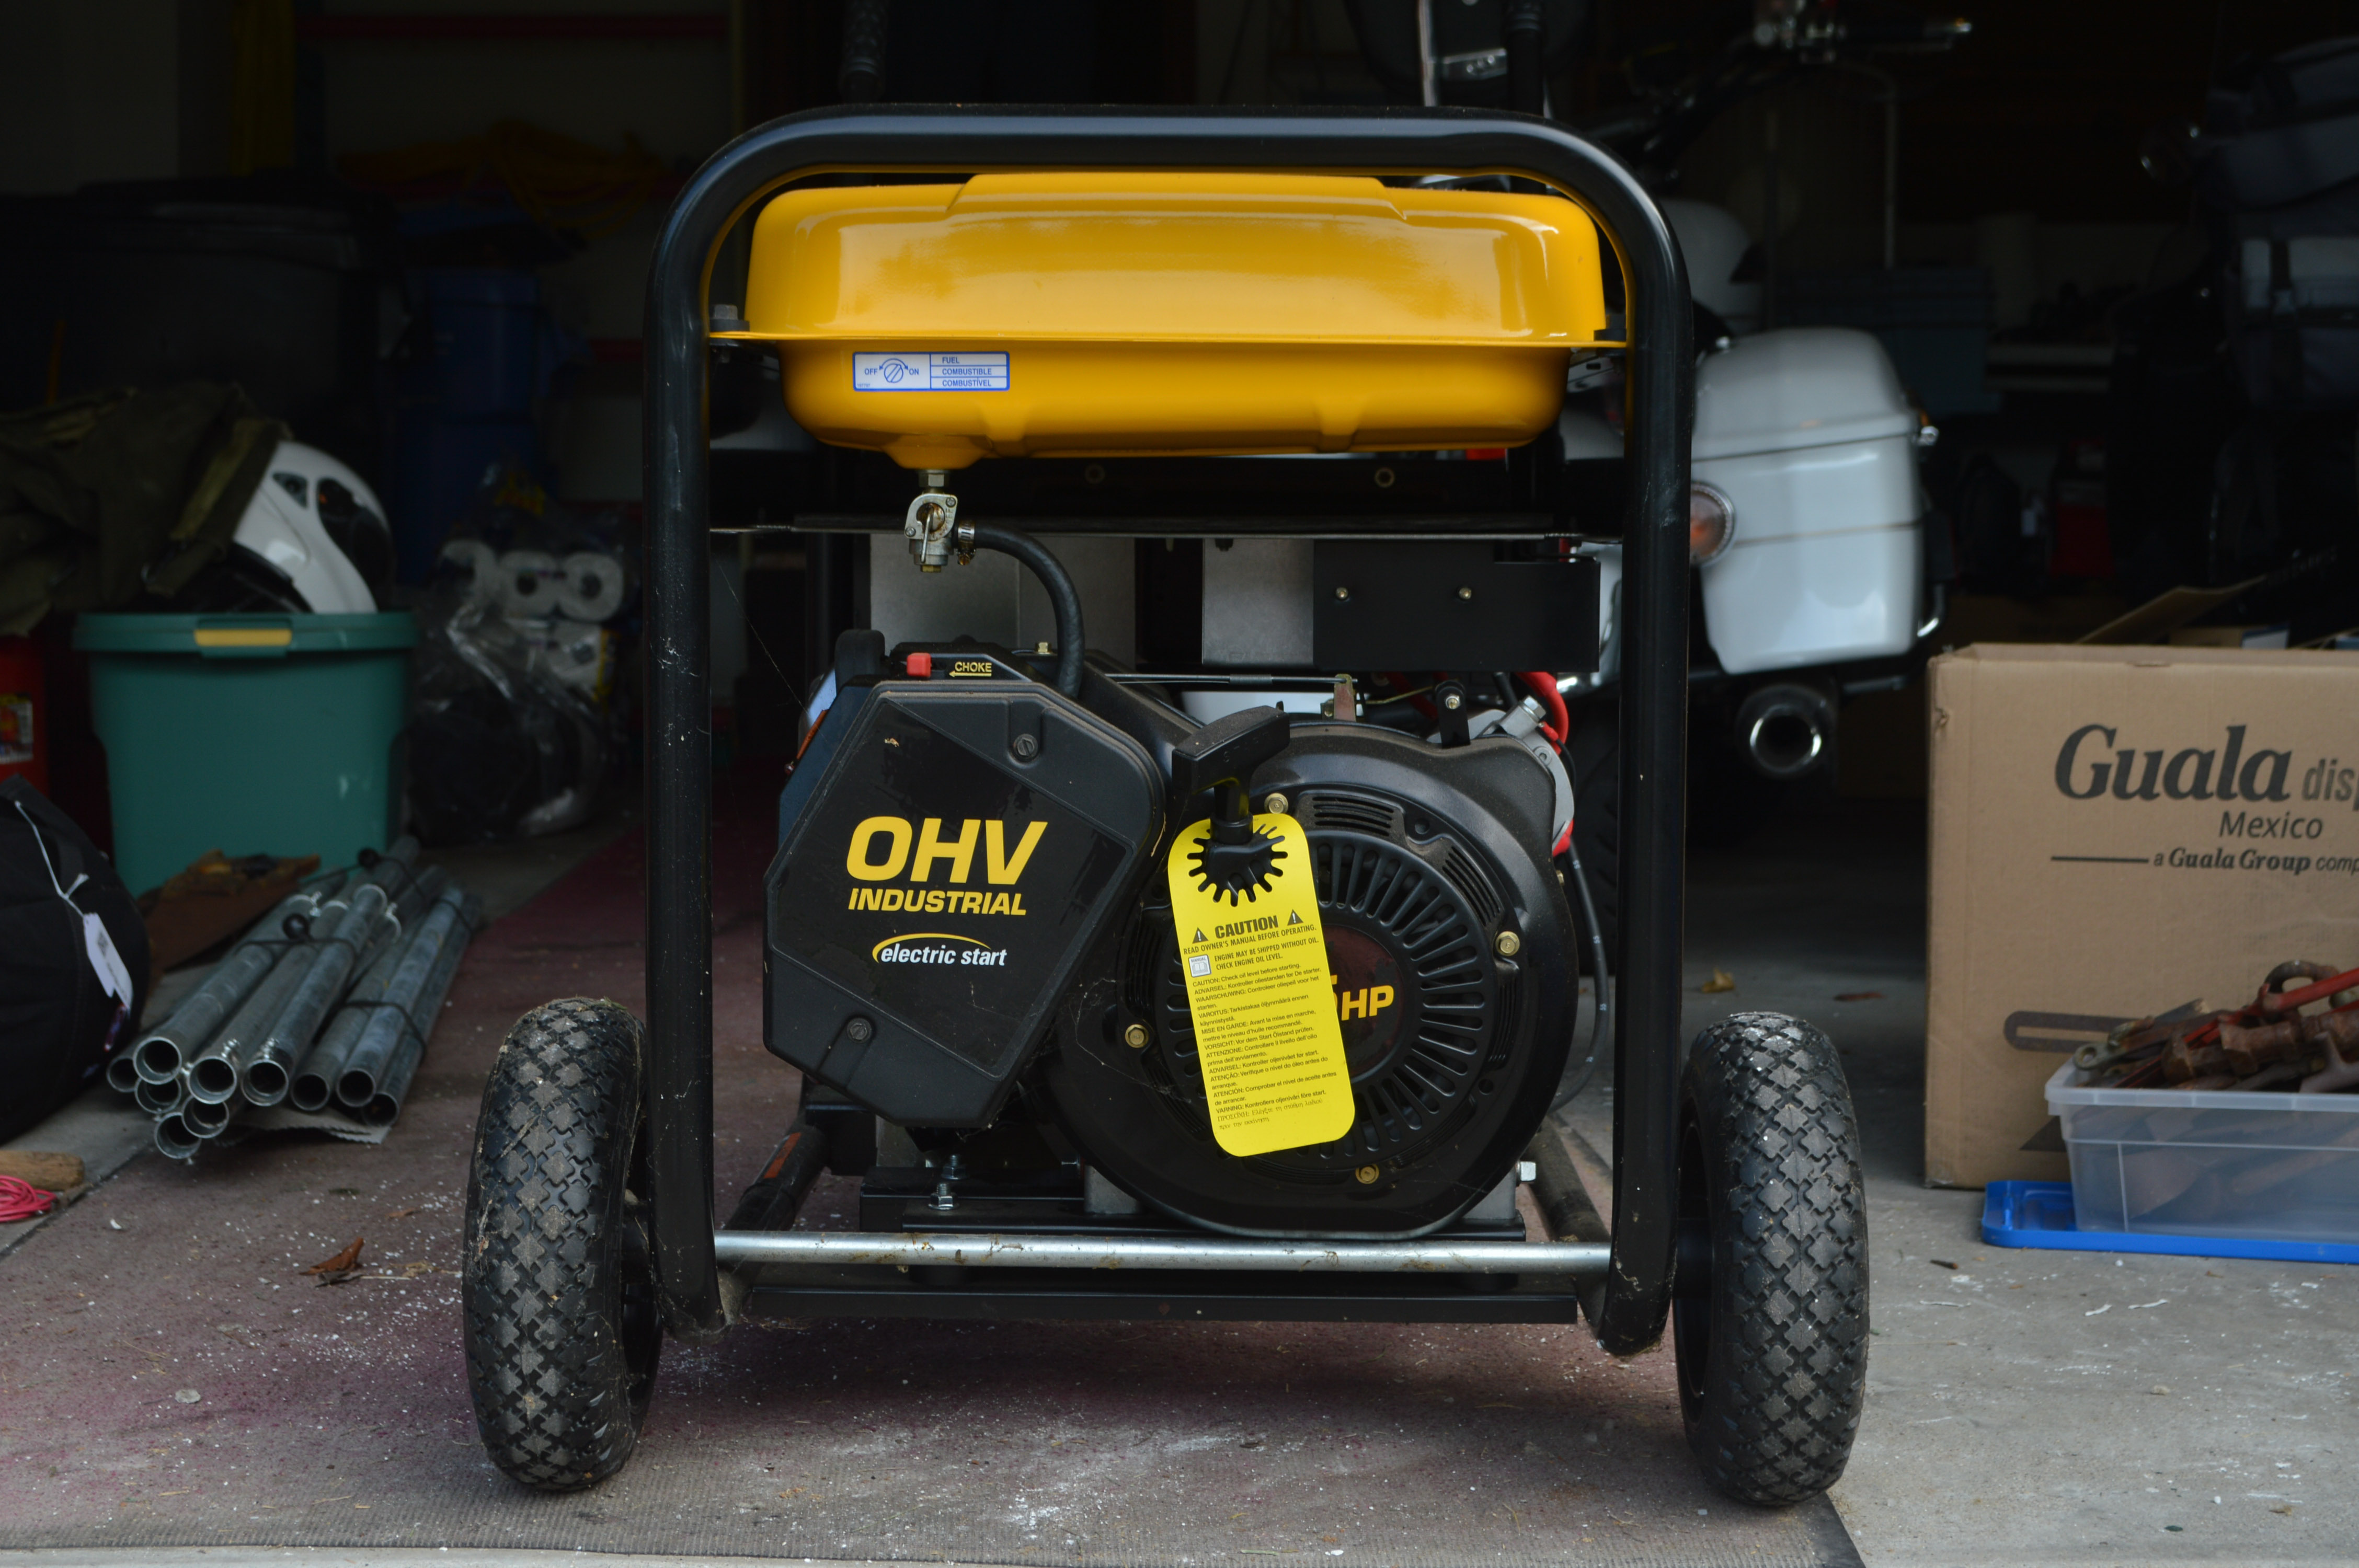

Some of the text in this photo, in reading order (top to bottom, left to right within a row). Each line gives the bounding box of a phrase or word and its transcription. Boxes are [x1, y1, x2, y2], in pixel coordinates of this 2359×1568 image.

[942, 377, 992, 387] COMBUSTÍVEL
[954, 662, 993, 673] CHOKE
[2055, 724, 2359, 811] Guala dis
[2219, 811, 2323, 839] Mexico
[846, 816, 1048, 885] OHV
[2154, 853, 2165, 867] a
[2169, 847, 2236, 870] Guala
[2239, 849, 2311, 876] Group
[848, 888, 1027, 916] INDUSTRIAL
[1215, 916, 1278, 939] CAUTION
[1183, 924, 1316, 955] READ OWNER'S MANUAL BEFORE OPERATING.
[881, 943, 1007, 966] electric start
[1214, 952, 1234, 962] ENGINE
[1235, 950, 1247, 958] MAY
[1257, 944, 1280, 954] SHIPPED
[1280, 939, 1307, 949] WITHOUT
[1216, 961, 1233, 971] CHECK
[1234, 958, 1254, 967] ENGINE
[1265, 952, 1283, 961] LEVEL.
[1228, 980, 1253, 989] Kontroller
[1254, 974, 1286, 984] oliestanden
[1247, 984, 1276, 994] Controleer
[1276, 979, 1296, 988] oliepeil
[1244, 1042, 1275, 1051] Controllare
[1240, 1068, 1264, 1077] Verifique
[1242, 1059, 1269, 1068] Kontroller
[1245, 1082, 1276, 1092] Comprobar
[1244, 1099, 1275, 1109] Kontrollera
